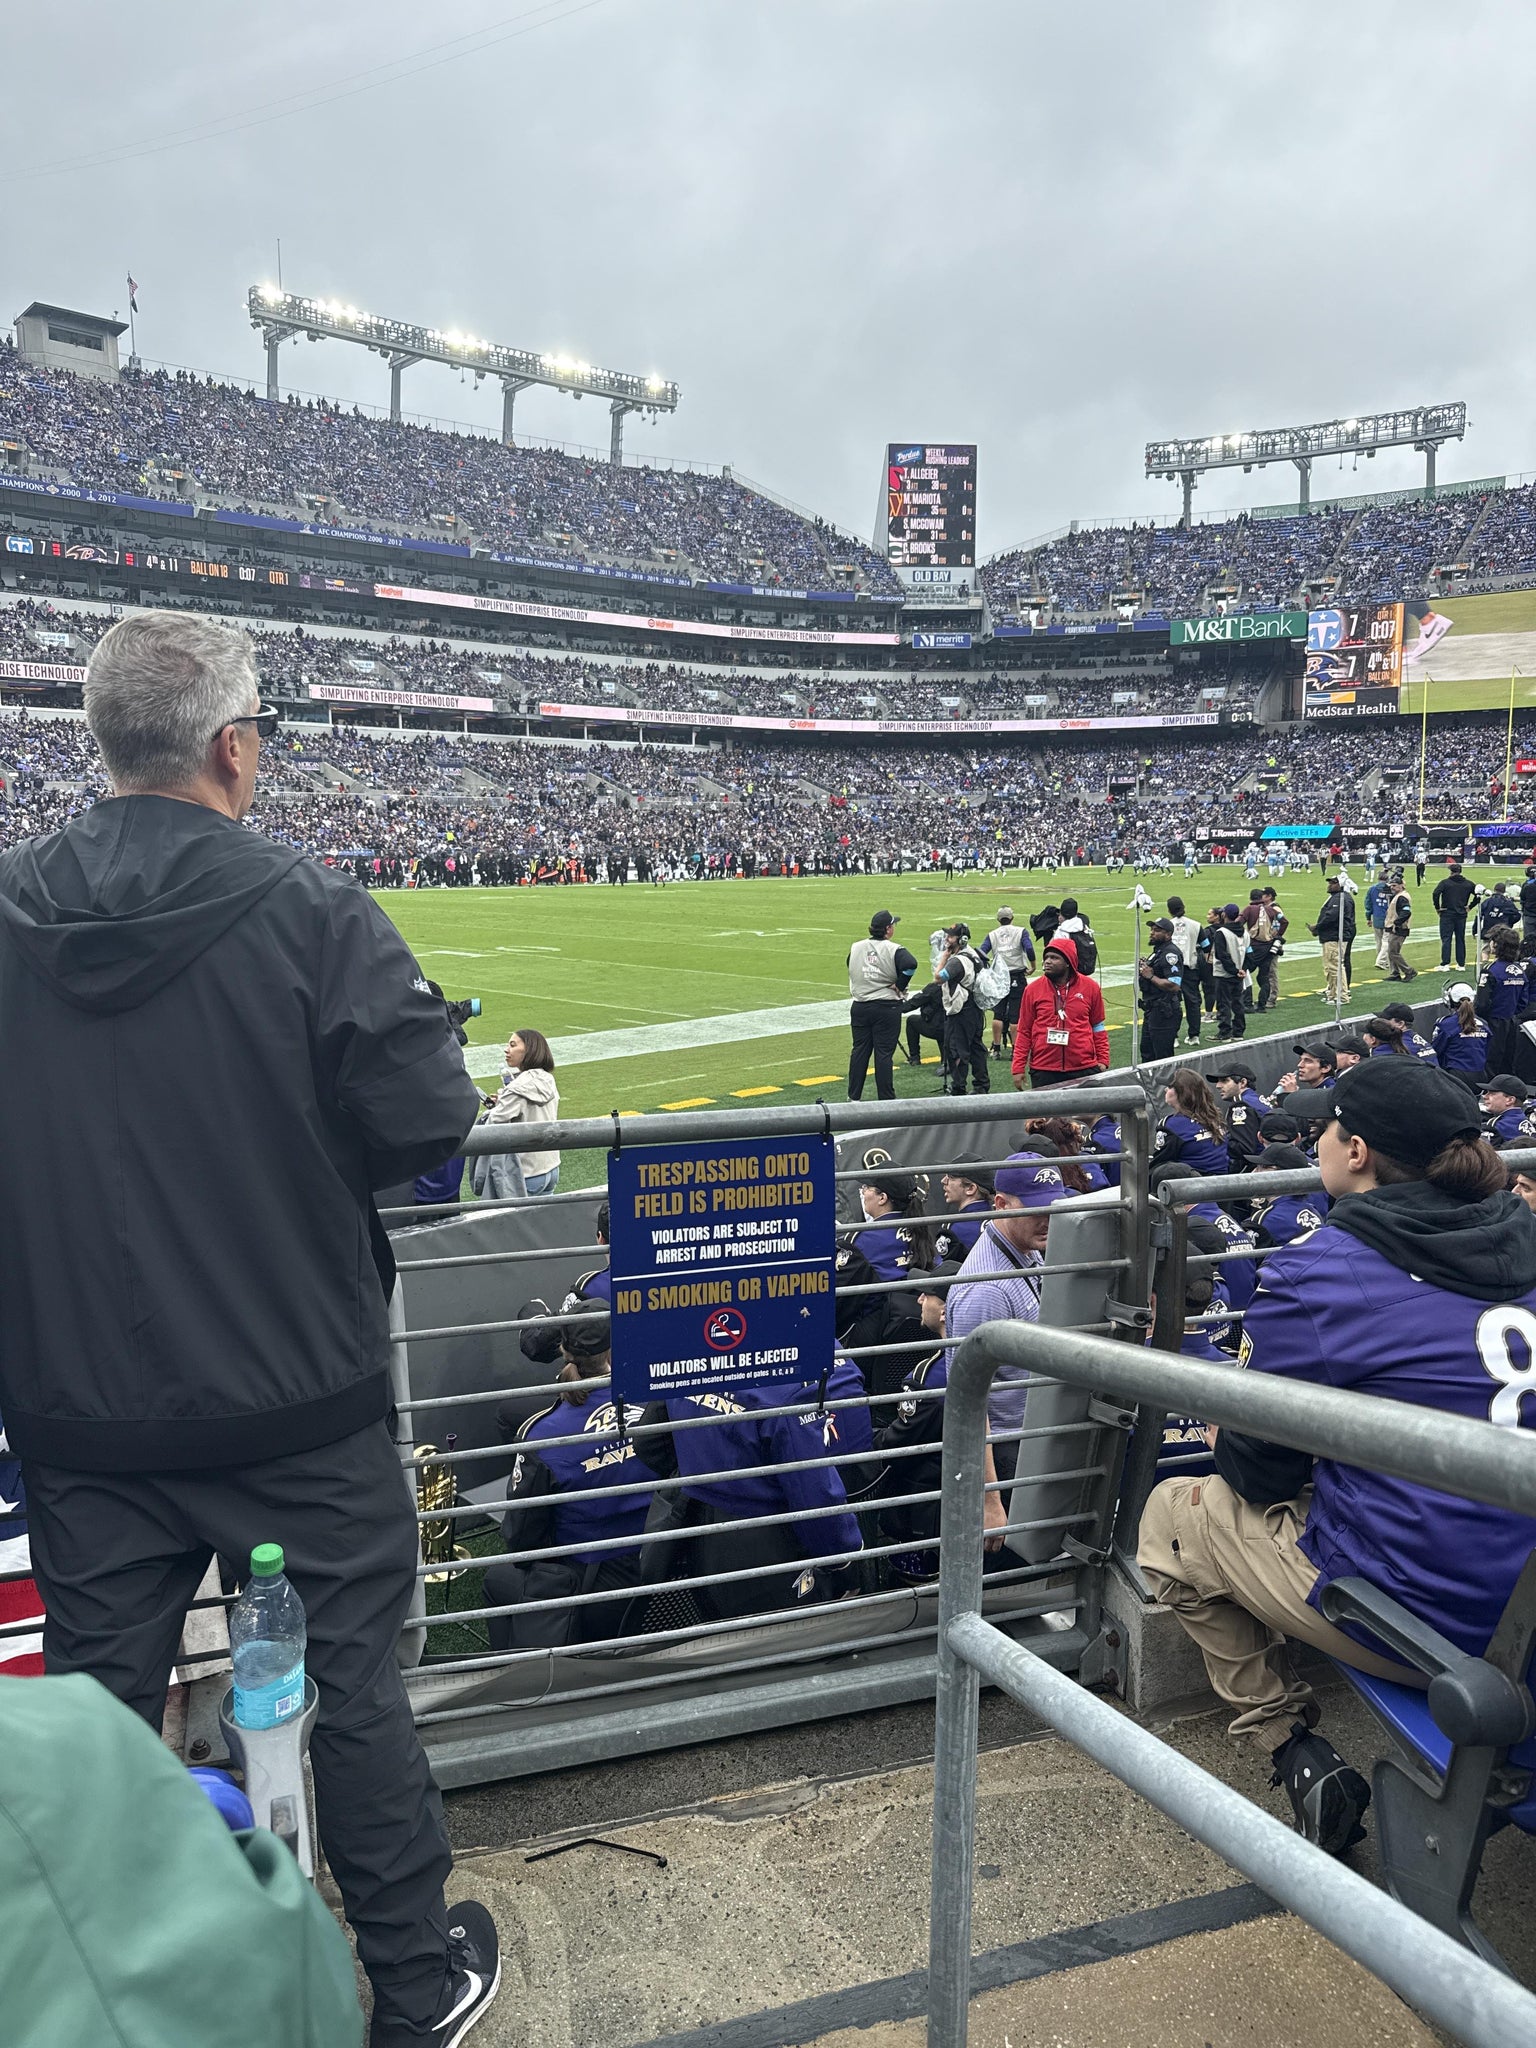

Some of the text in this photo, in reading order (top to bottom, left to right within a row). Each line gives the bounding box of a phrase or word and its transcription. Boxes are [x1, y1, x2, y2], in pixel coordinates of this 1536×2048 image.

[925, 448, 945, 457] WEEKLY
[948, 457, 969, 465] LEADERS
[910, 468, 938, 479] ALLGEIER
[0, 479, 117, 503] CHAMPIONS 2000 2012
[912, 493, 941, 504] MARIOTA
[910, 518, 944, 530] MCGOWAN
[318, 528, 403, 546] AFC CHAMPIONS 2000 2012
[40, 541, 46, 555] 7
[910, 543, 936, 554] BROOKS
[114, 551, 120, 565] 7
[160, 560, 166, 570] &
[168, 558, 178, 572] 11
[515, 557, 533, 565] NORTH
[534, 560, 564, 569] CHAMPIONS
[190, 561, 228, 578] BALL ON 18
[239, 567, 256, 581] 0:07
[914, 571, 949, 581] OLD BAY
[269, 570, 285, 585] QTR
[473, 598, 588, 621] SIMPLIFYING ENTERPRISE TECHNOLOGY
[1183, 615, 1292, 643] M&T Bank
[1350, 614, 1358, 636] 7
[1371, 621, 1396, 639] 0:07
[730, 628, 834, 642] SIMPLIFYING ENTERPRISE TECHNOLOGY
[936, 634, 964, 643] merritt
[1347, 656, 1356, 677] 7
[1368, 651, 1399, 671] 4th & 11
[23, 664, 85, 680] TECHNOLOGY
[1368, 672, 1381, 681] BALL
[1382, 672, 1390, 680] ON
[320, 687, 459, 708] SIMPLIFYING ENTERPRISE TECHNOLOGY
[626, 710, 733, 725] SIMPLIFYING ENTERPRISE TECHNOLOGY
[1307, 703, 1397, 718] MedStar Health
[878, 722, 992, 731] SIMPLIFYING ENTERPRISE TECHNOLOGY
[1162, 715, 1205, 725] SIMPLIFYING
[638, 1152, 810, 1188] TRESPASSING ONTO
[634, 1181, 814, 1219] FIELD IS PROHIBITED
[652, 1218, 798, 1245] VIOLATORS ARE SUBJECT TO
[656, 1238, 795, 1264] ARREST AND PROSECUTION
[616, 1270, 829, 1314] NO SMOKING OR VAPING
[649, 1347, 798, 1378] VIOLATORS WILL BE EJECTED
[650, 1380, 674, 1391] Smoking
[676, 1379, 690, 1388] pens
[691, 1378, 700, 1386] are
[702, 1374, 723, 1384] located
[724, 1372, 745, 1381] outside
[753, 1370, 769, 1379] gates
[799, 1412, 817, 1425] M&T
